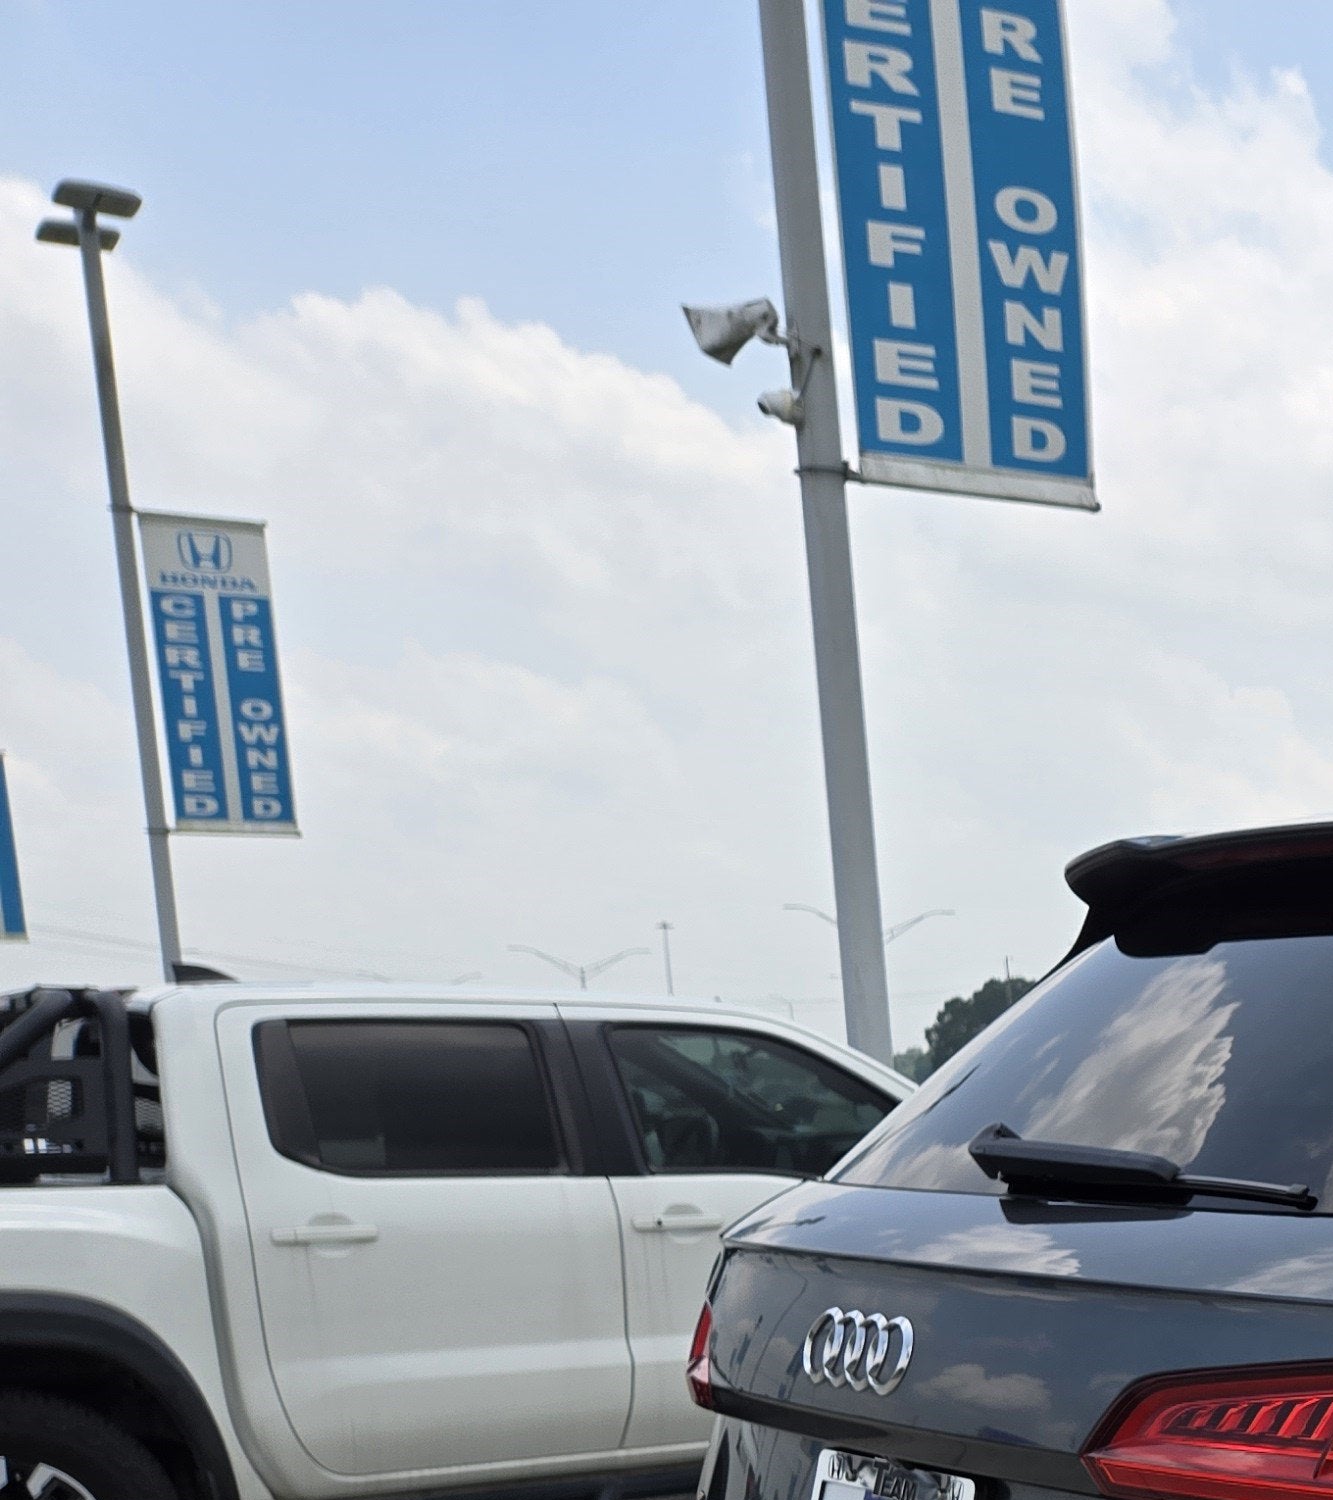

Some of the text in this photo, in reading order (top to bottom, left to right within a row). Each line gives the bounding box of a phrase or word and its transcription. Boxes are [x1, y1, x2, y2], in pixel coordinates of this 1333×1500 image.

[987, 185, 1070, 464] OWNED
[159, 571, 256, 591] HONDA
[158, 593, 220, 818] CERTIFIED
[230, 599, 283, 820] PRE OWNED
